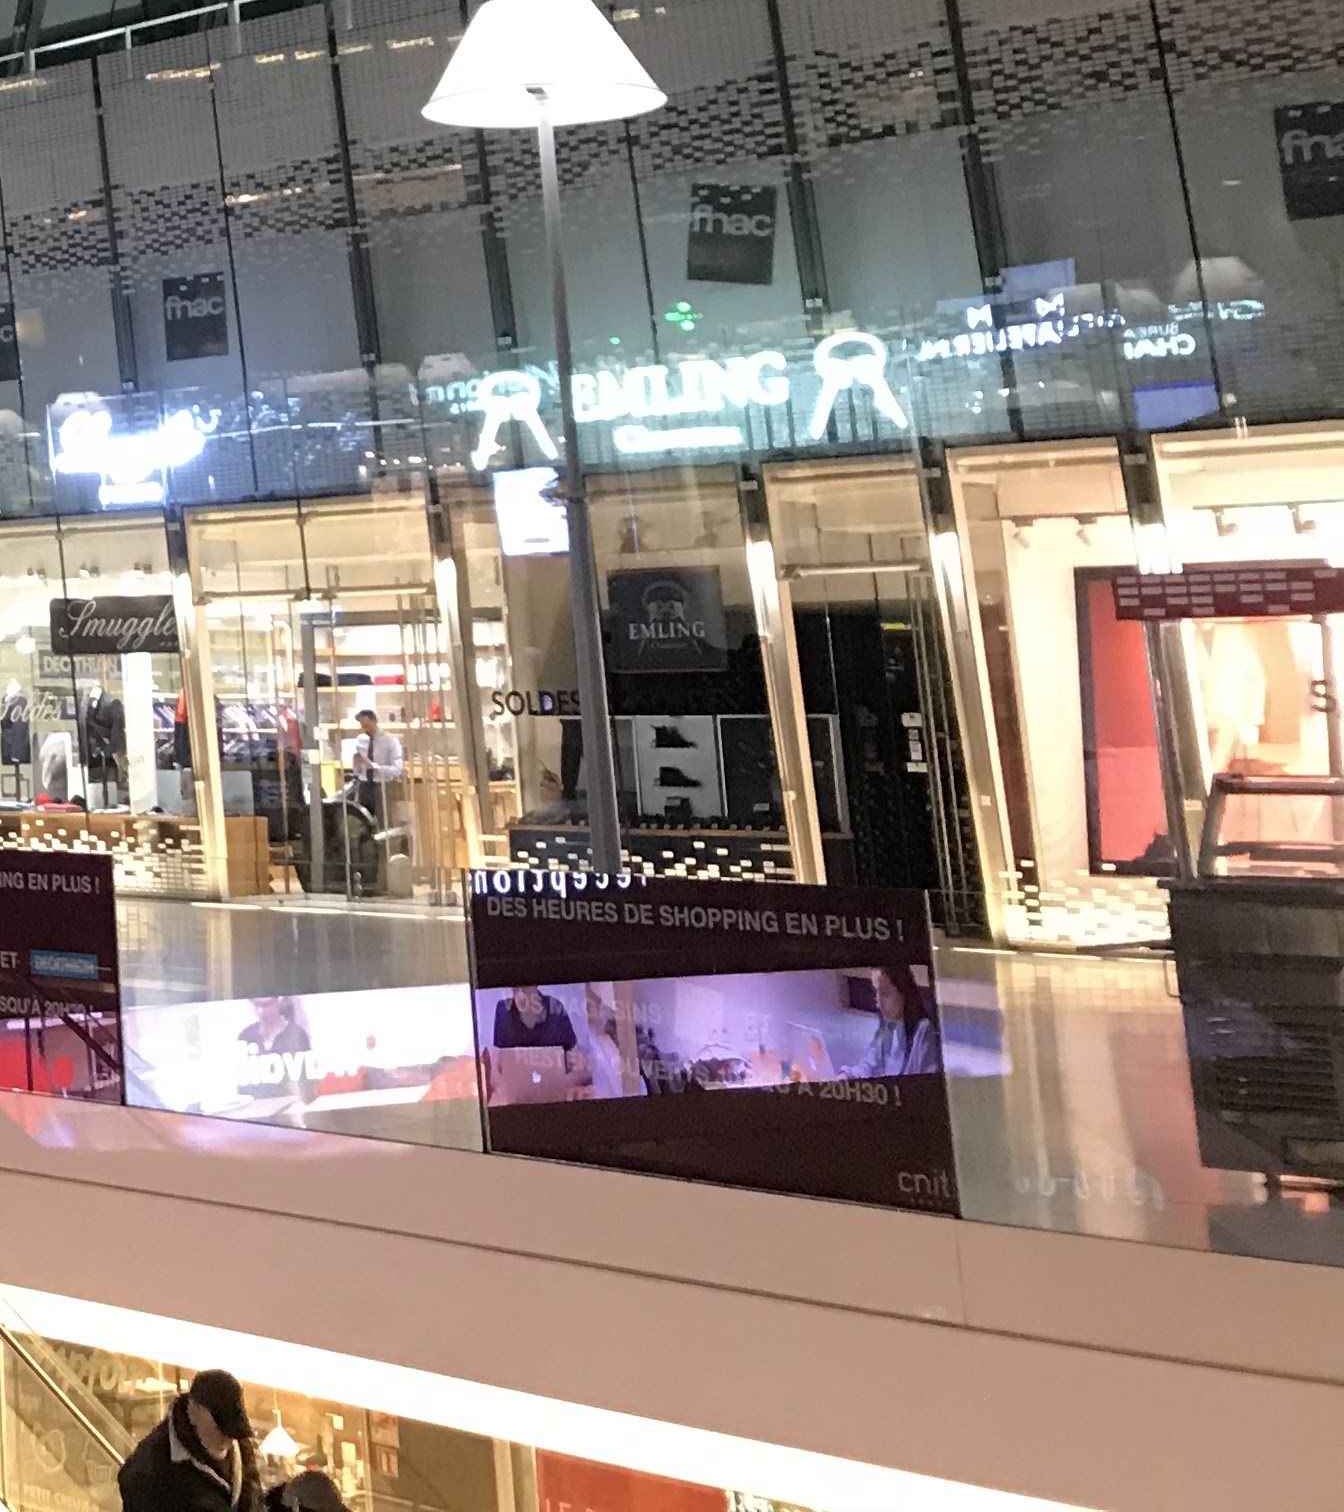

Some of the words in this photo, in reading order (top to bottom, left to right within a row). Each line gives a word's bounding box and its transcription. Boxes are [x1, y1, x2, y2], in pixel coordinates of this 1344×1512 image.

[1282, 129, 1344, 165] fna
[691, 204, 772, 236] fnac
[165, 295, 223, 320] fnac
[571, 350, 791, 423] EMLING
[59, 599, 180, 650] Smuggle
[628, 620, 706, 640] EMLING
[27, 872, 48, 892] EN
[52, 873, 92, 895] PLUS
[487, 896, 528, 920] DES
[532, 898, 618, 925] HEURES
[624, 902, 655, 926] DE
[660, 905, 780, 936] SHOPPING
[785, 912, 820, 938] EN
[824, 915, 892, 942] PLUS
[0, 950, 19, 970] ET
[819, 1082, 889, 1106] 20H30
[898, 1168, 951, 1199] cnit
